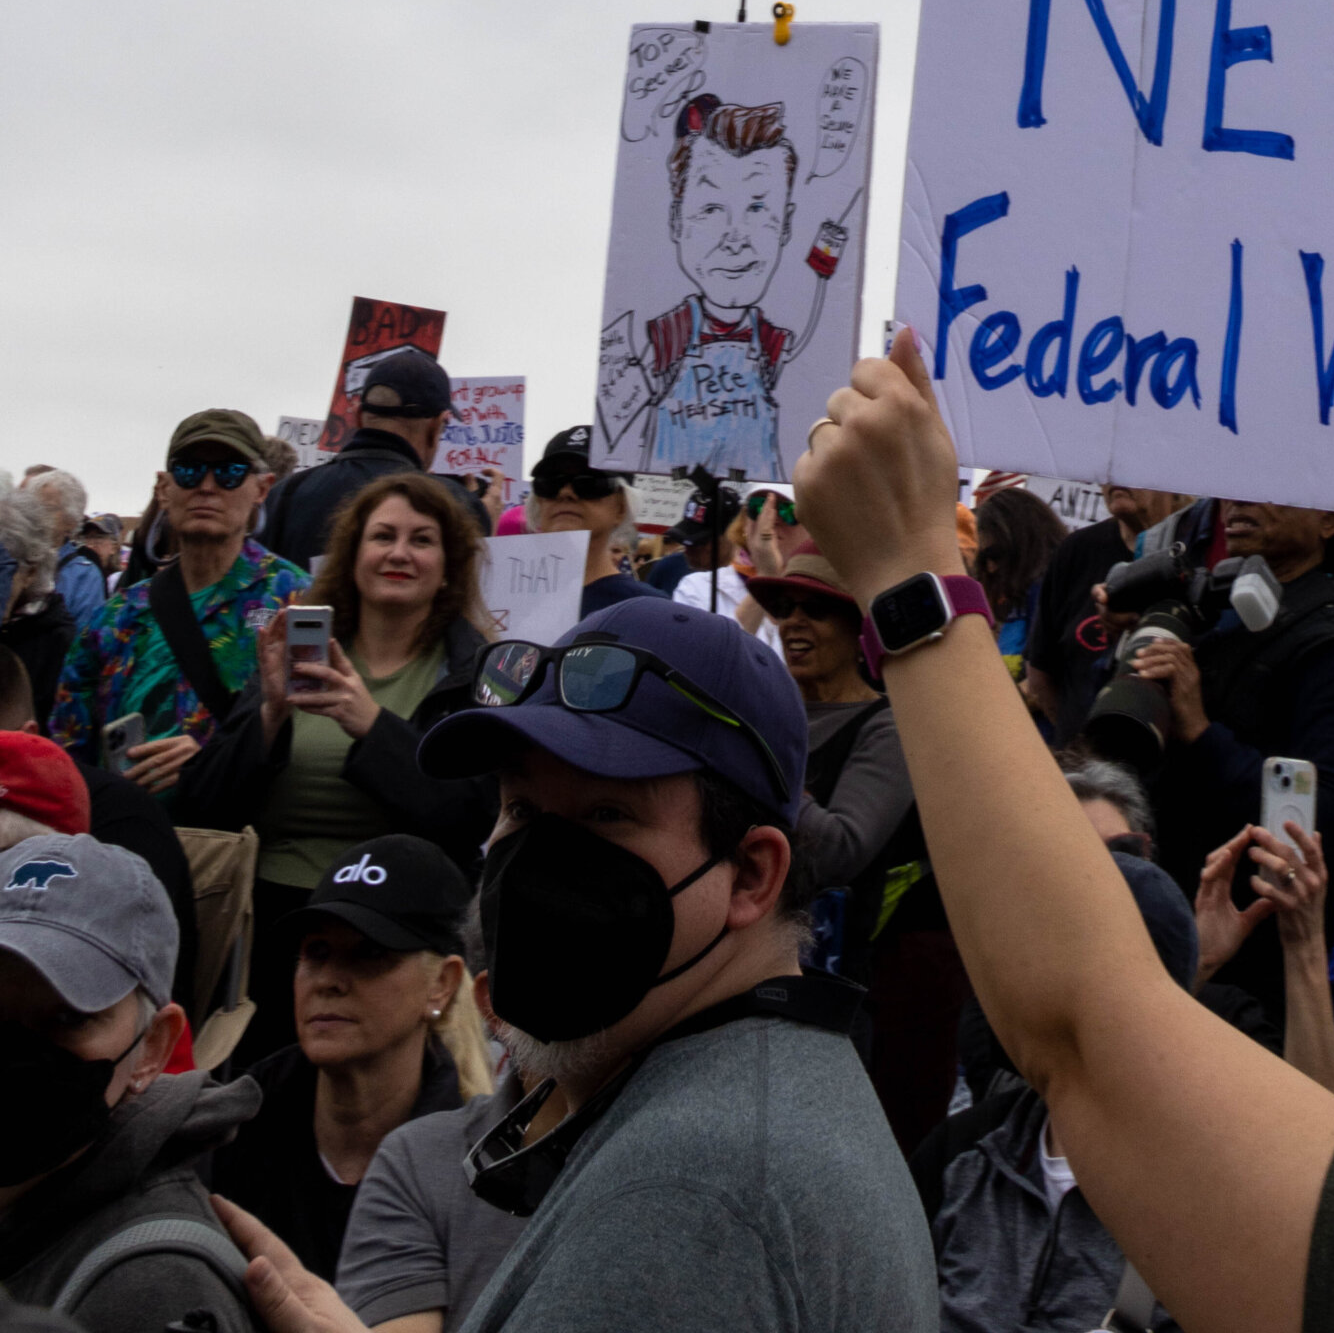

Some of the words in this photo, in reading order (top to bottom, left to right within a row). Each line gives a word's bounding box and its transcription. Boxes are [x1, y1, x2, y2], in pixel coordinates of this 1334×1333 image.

[630, 33, 676, 68] TOP
[352, 300, 421, 346] BAD
[934, 191, 1243, 434] Federal
[692, 363, 748, 401] Pete
[508, 554, 564, 594] THAT
[333, 853, 387, 886] alo
